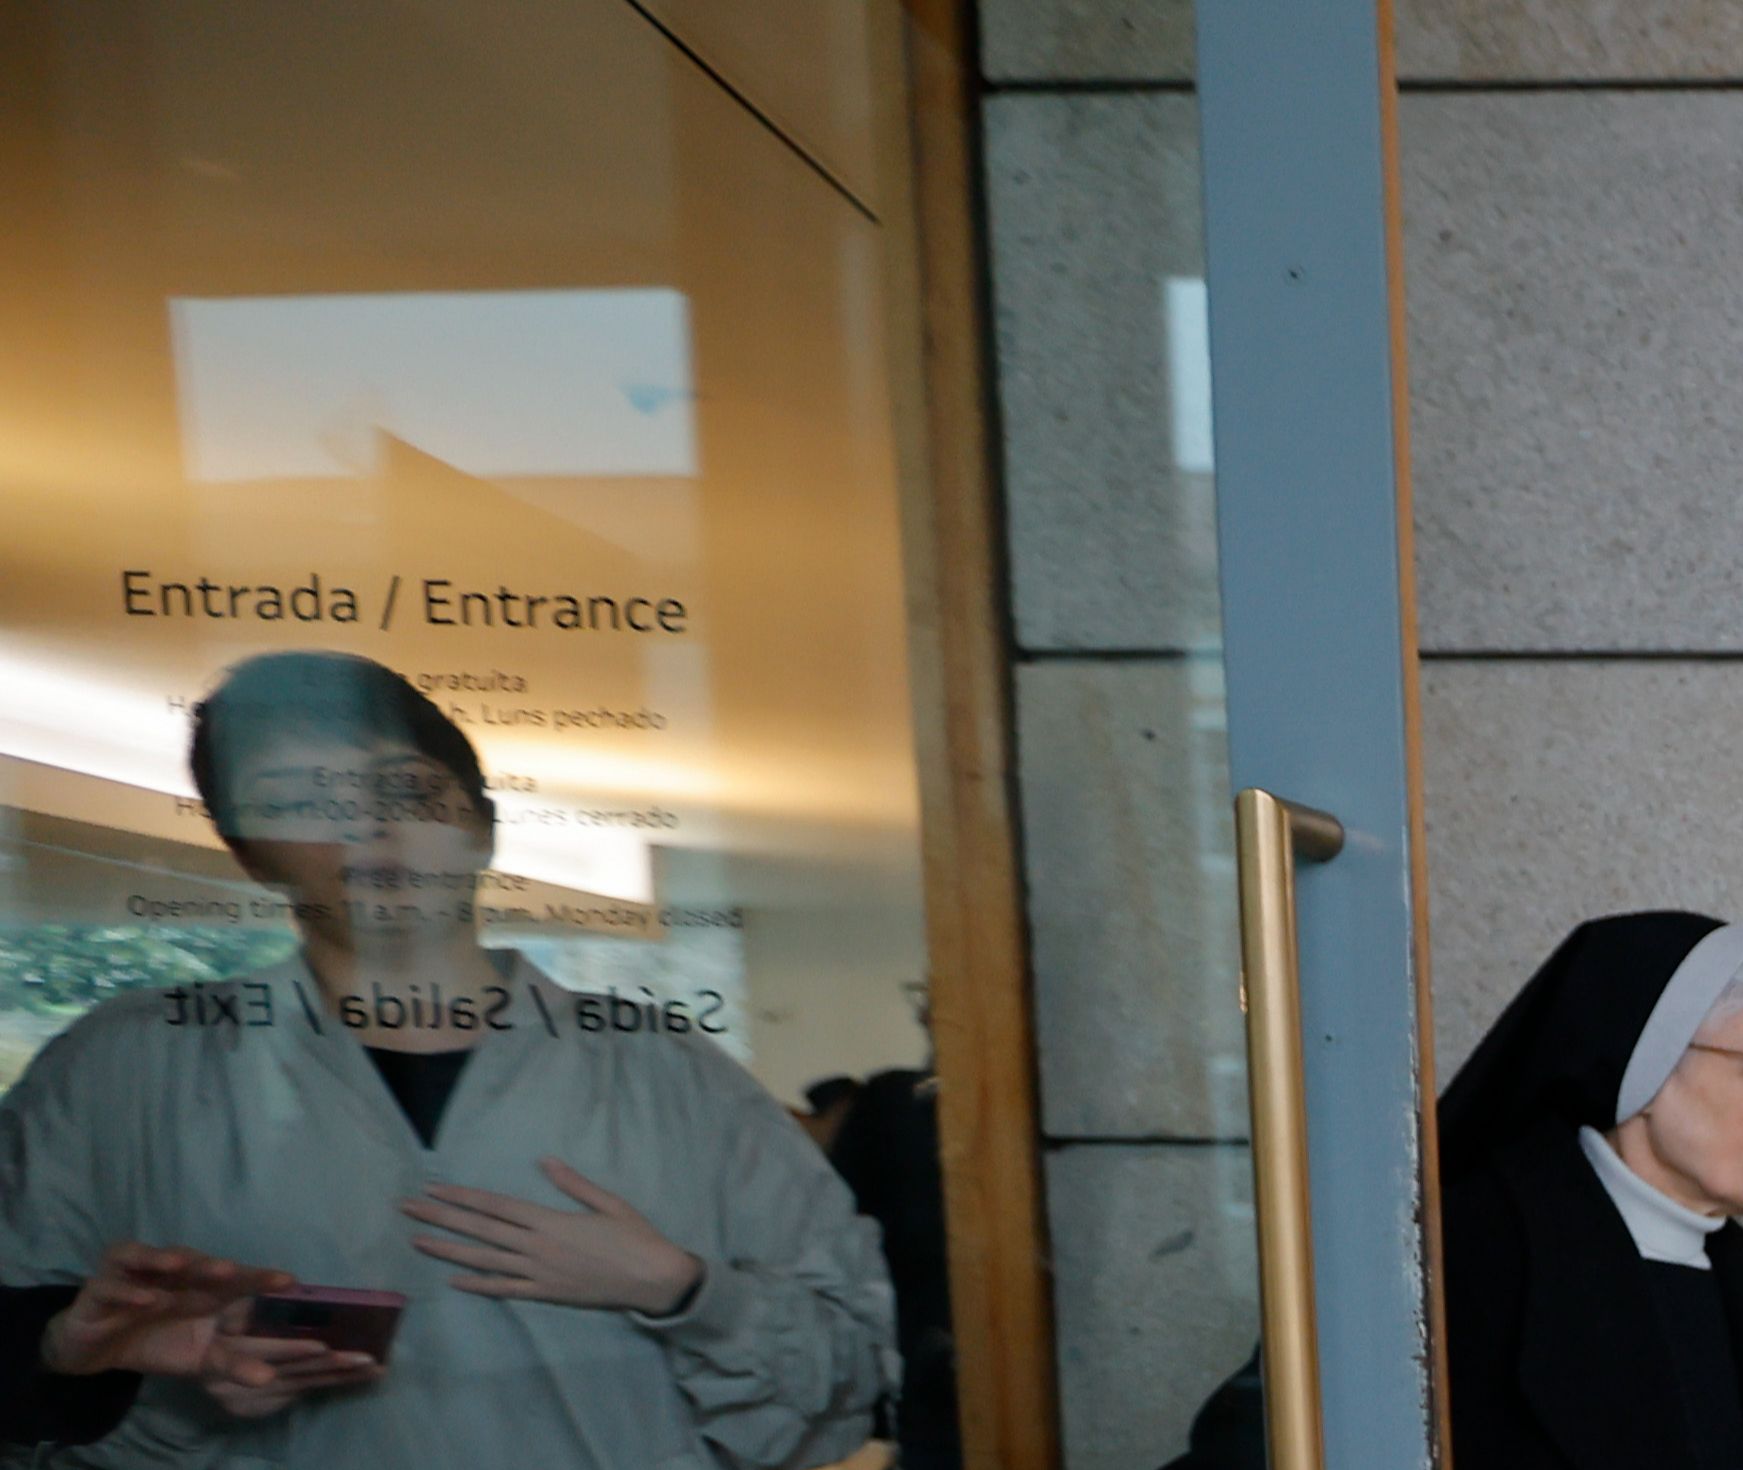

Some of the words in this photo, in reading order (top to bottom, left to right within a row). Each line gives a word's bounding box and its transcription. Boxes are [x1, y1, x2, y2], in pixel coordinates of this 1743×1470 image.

[121, 569, 359, 624] Entrada
[378, 574, 402, 632] /
[422, 578, 689, 634] Entrance
[417, 668, 529, 698] gratuita
[480, 702, 550, 728] Luns
[552, 705, 669, 732] pechado
[575, 803, 680, 831] cerrado
[127, 894, 241, 925] Opening
[545, 903, 652, 931] Monday
